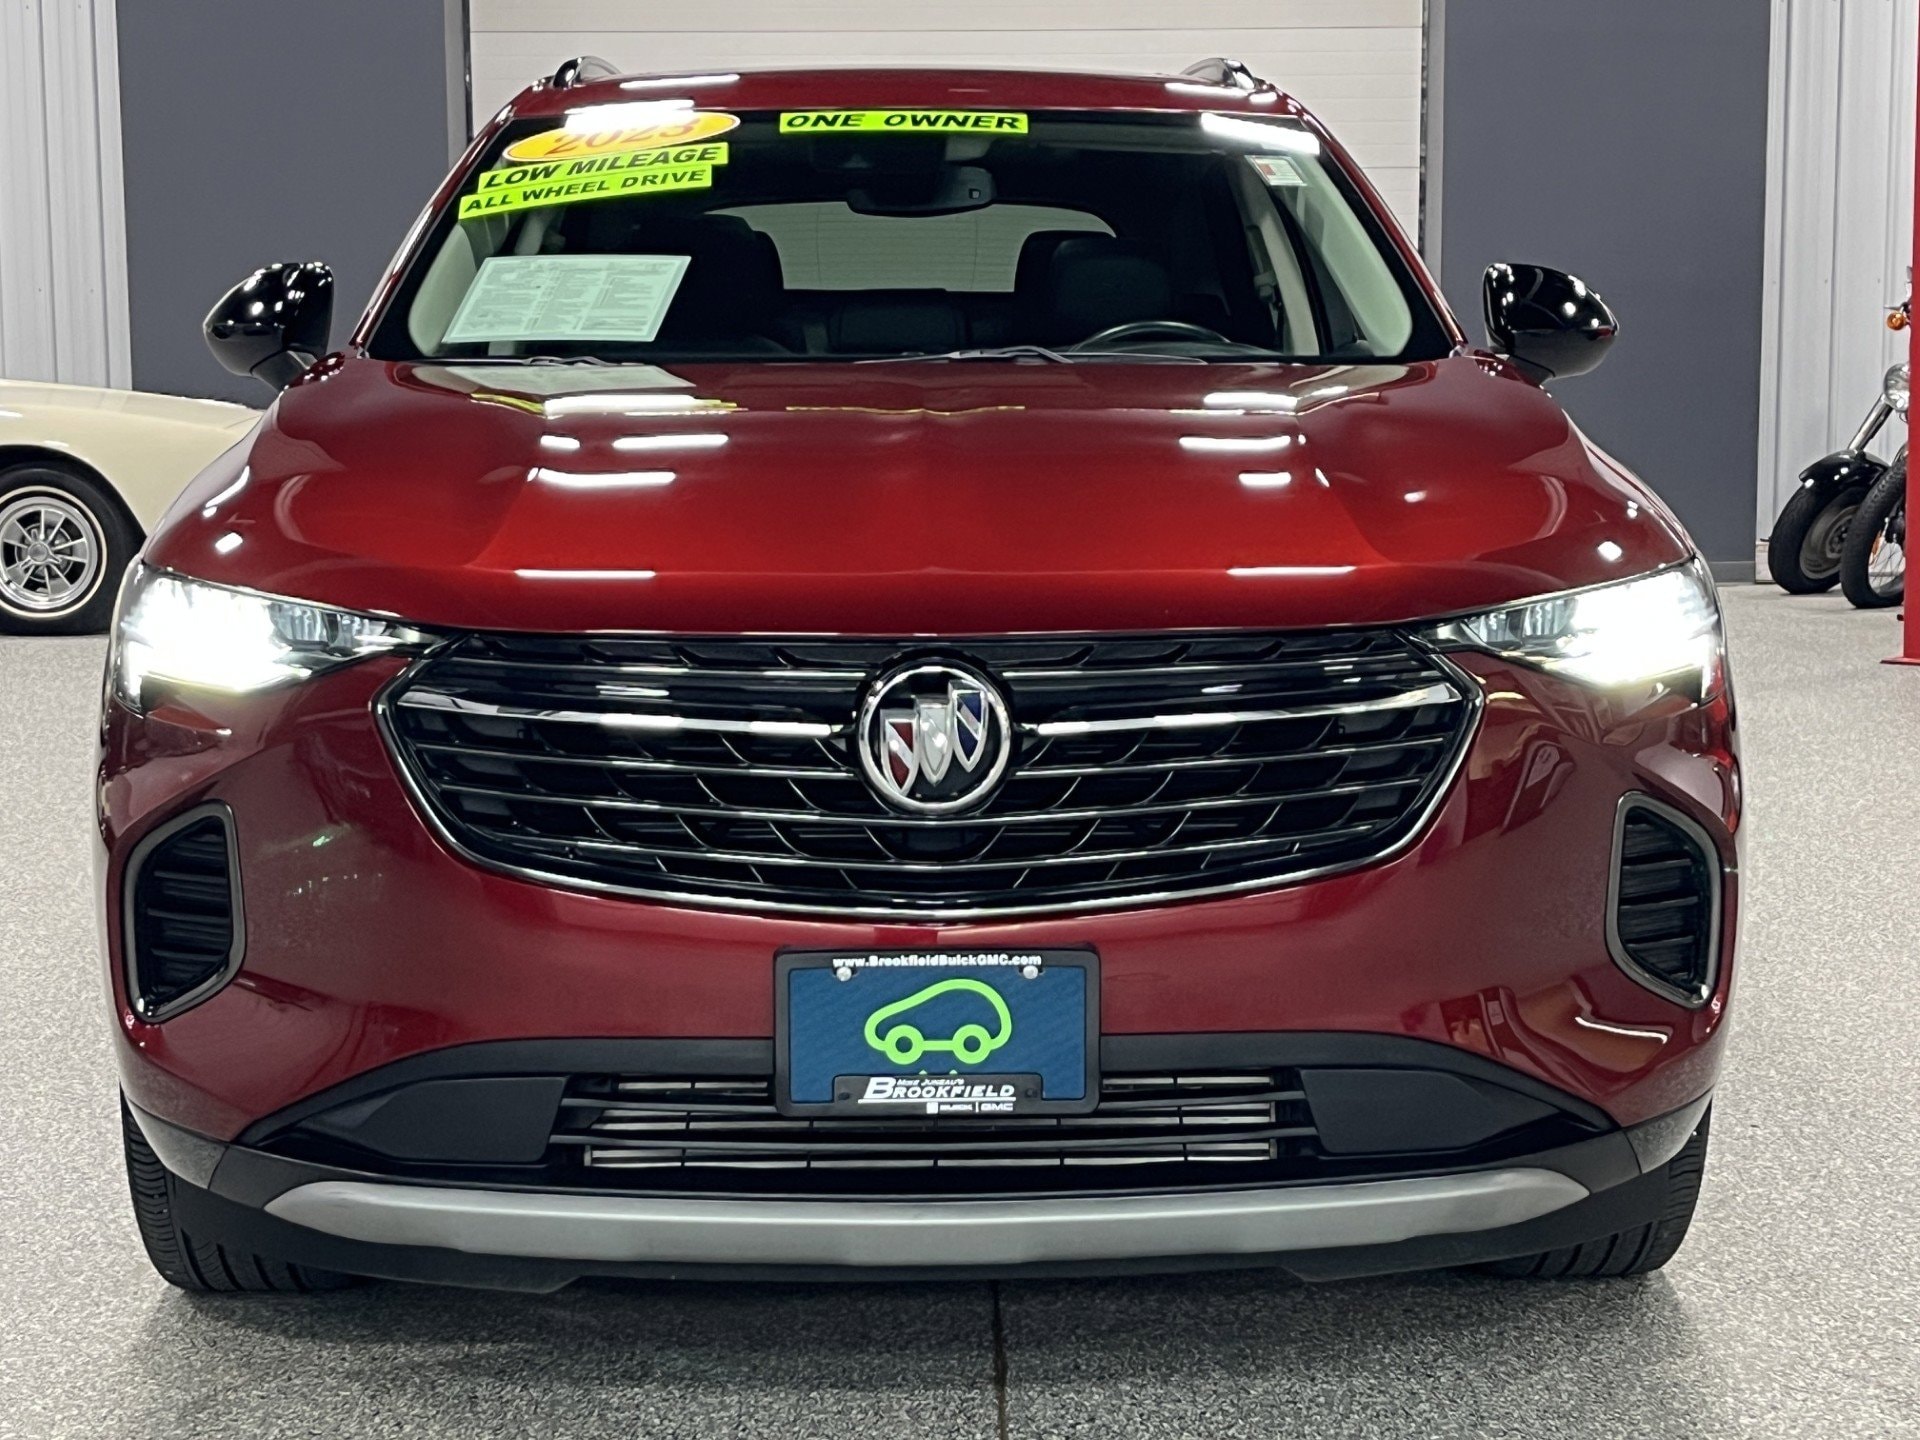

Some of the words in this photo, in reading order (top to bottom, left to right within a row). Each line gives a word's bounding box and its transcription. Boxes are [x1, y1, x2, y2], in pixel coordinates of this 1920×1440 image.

[786, 113, 866, 128] ONE
[884, 113, 1022, 130] OWNER
[483, 164, 561, 189] LOW
[566, 146, 722, 176] MILEAGE
[464, 194, 513, 213] ALL
[522, 180, 611, 202] WHEEL
[621, 169, 707, 189] DRIVE
[832, 954, 1042, 967] www.BrookfieldBuickGMC.com
[863, 1076, 1015, 1099] BROOKFIELD
[980, 1102, 1014, 1111] GMC
